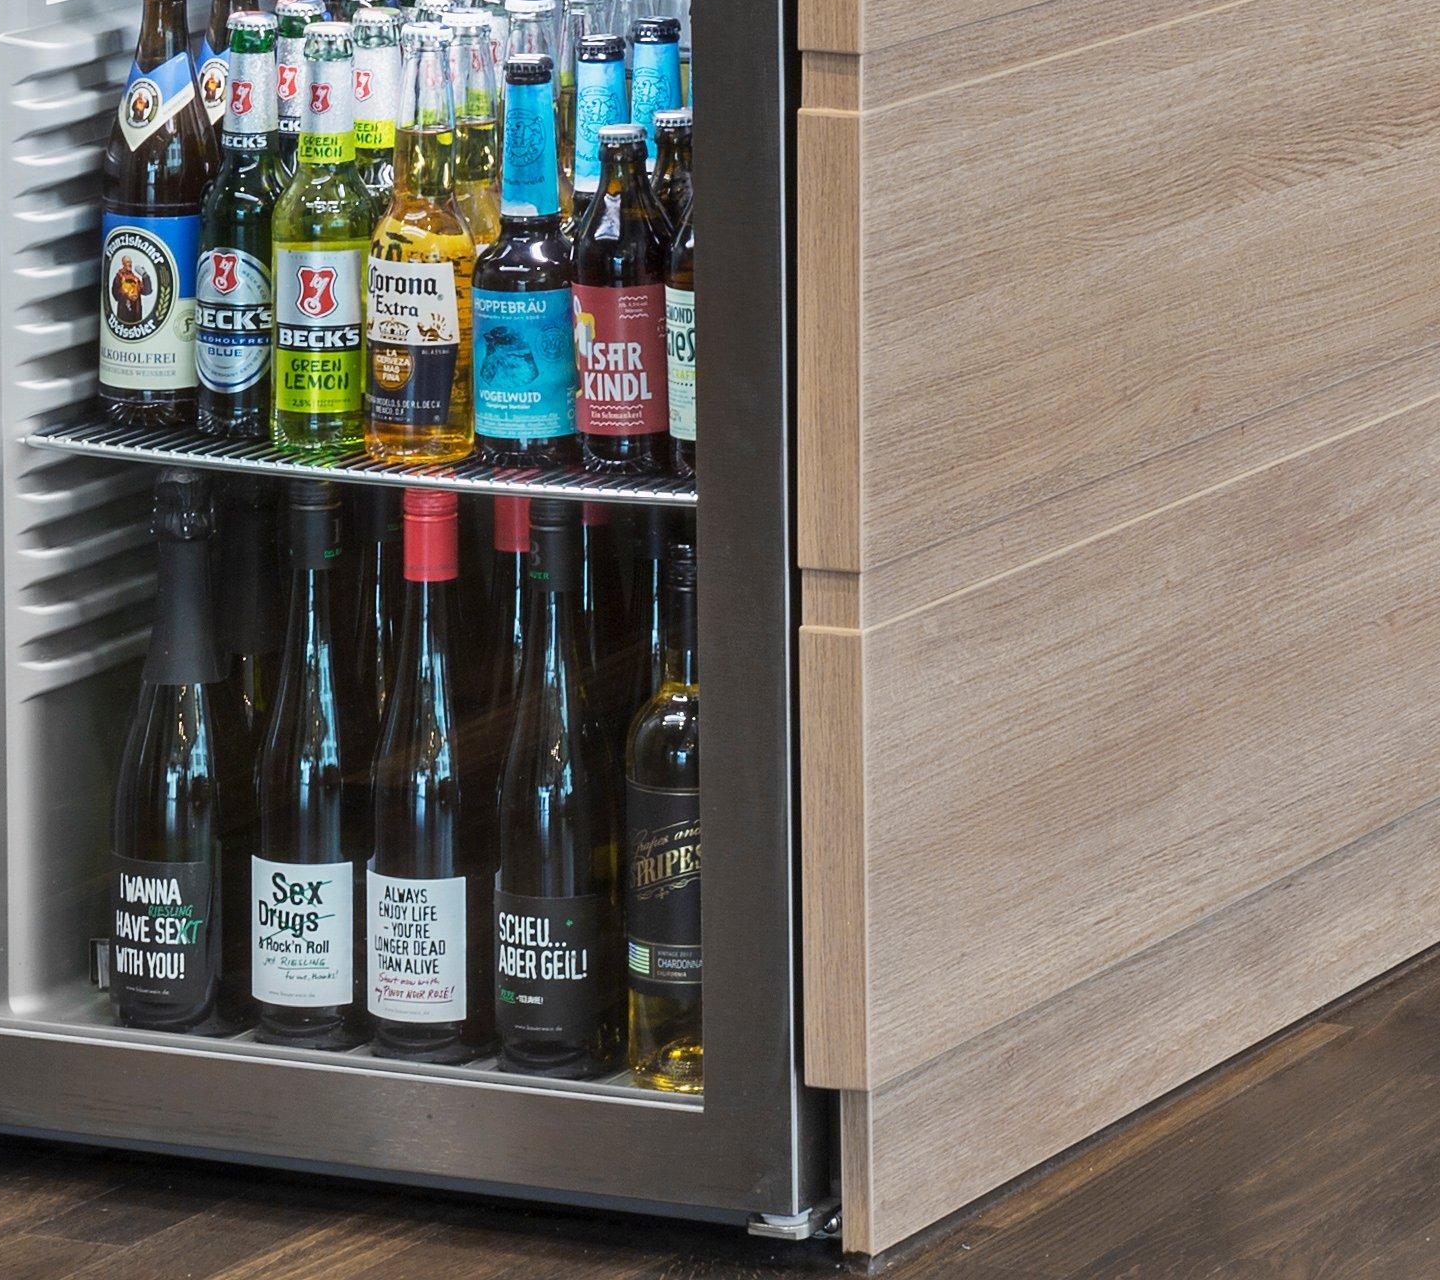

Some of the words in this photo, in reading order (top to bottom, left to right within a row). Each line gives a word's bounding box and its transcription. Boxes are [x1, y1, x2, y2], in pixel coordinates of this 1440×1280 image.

[300, 146, 342, 158] LEMON
[368, 261, 436, 299] Corona
[375, 295, 418, 318] Extra
[474, 297, 547, 315] HOPPEBRÄU
[196, 308, 273, 332] BECK'S
[279, 327, 360, 348] BECK'S
[207, 347, 243, 358] BLUE
[377, 356, 410, 367] CERVEZA
[587, 342, 643, 371] ISAR
[291, 358, 342, 373] GREEN
[284, 372, 349, 390] LEMON
[584, 372, 652, 402] KINDL
[479, 390, 541, 404] VOGELWUID
[120, 873, 124, 898] I
[125, 875, 182, 905] WANNA
[272, 872, 323, 906] Sex
[384, 885, 428, 904] ALWAYS
[147, 904, 193, 917] RIESLING
[259, 900, 319, 938] Drugs
[379, 903, 407, 921] ENJOY
[412, 906, 437, 921] LIFE
[116, 910, 150, 943] HAVE
[498, 911, 567, 948] SCHEU...
[266, 937, 302, 954] Rock'n
[307, 940, 330, 954] Roll
[375, 939, 409, 956] LONGER
[413, 940, 446, 956] DEAD
[116, 945, 144, 976] WITH
[147, 951, 185, 979] YOU!
[378, 954, 402, 972] THAN
[406, 958, 439, 975] ALIVE
[499, 945, 536, 979] ABER
[541, 949, 588, 980] GEIL!
